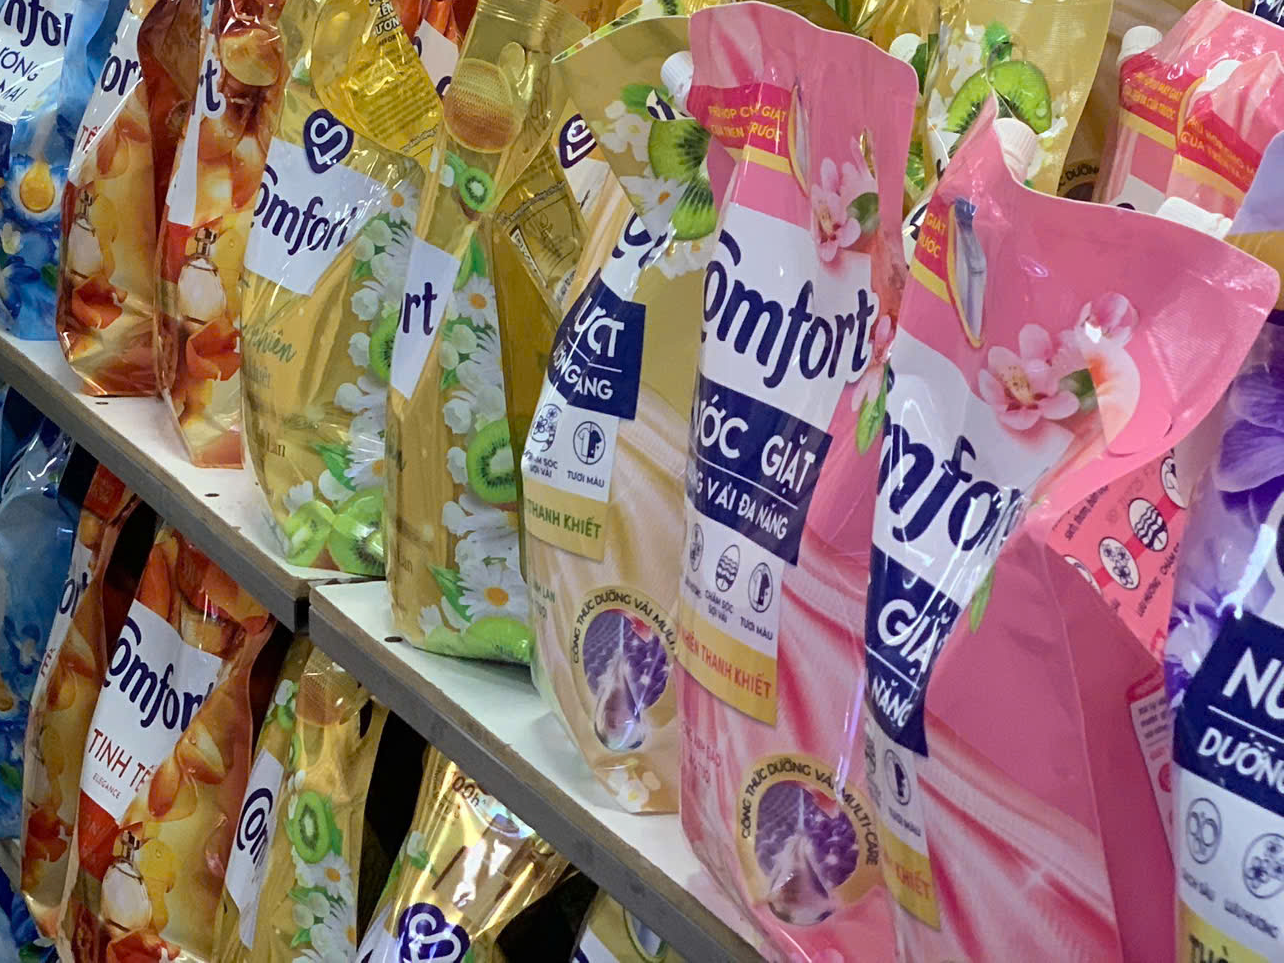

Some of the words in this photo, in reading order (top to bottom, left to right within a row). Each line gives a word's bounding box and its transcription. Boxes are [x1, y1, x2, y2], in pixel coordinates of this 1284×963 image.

[761, 434, 816, 495] GIẶT
[586, 474, 605, 488] MÀU
[707, 477, 737, 512] VẢI
[738, 493, 758, 521] ĐA
[757, 502, 789, 541] NĂNG
[563, 514, 602, 540] KHIẾT
[594, 589, 632, 606] DƯỠNG
[634, 597, 653, 617] VẢI
[700, 644, 733, 682] THANH
[734, 668, 772, 700] KHIẾT
[88, 728, 133, 779] TINH
[766, 757, 812, 777] DƯỠNG
[93, 772, 122, 800] ELEGANCE
[746, 767, 768, 798] THỨC
[741, 799, 752, 839] CÔNG
